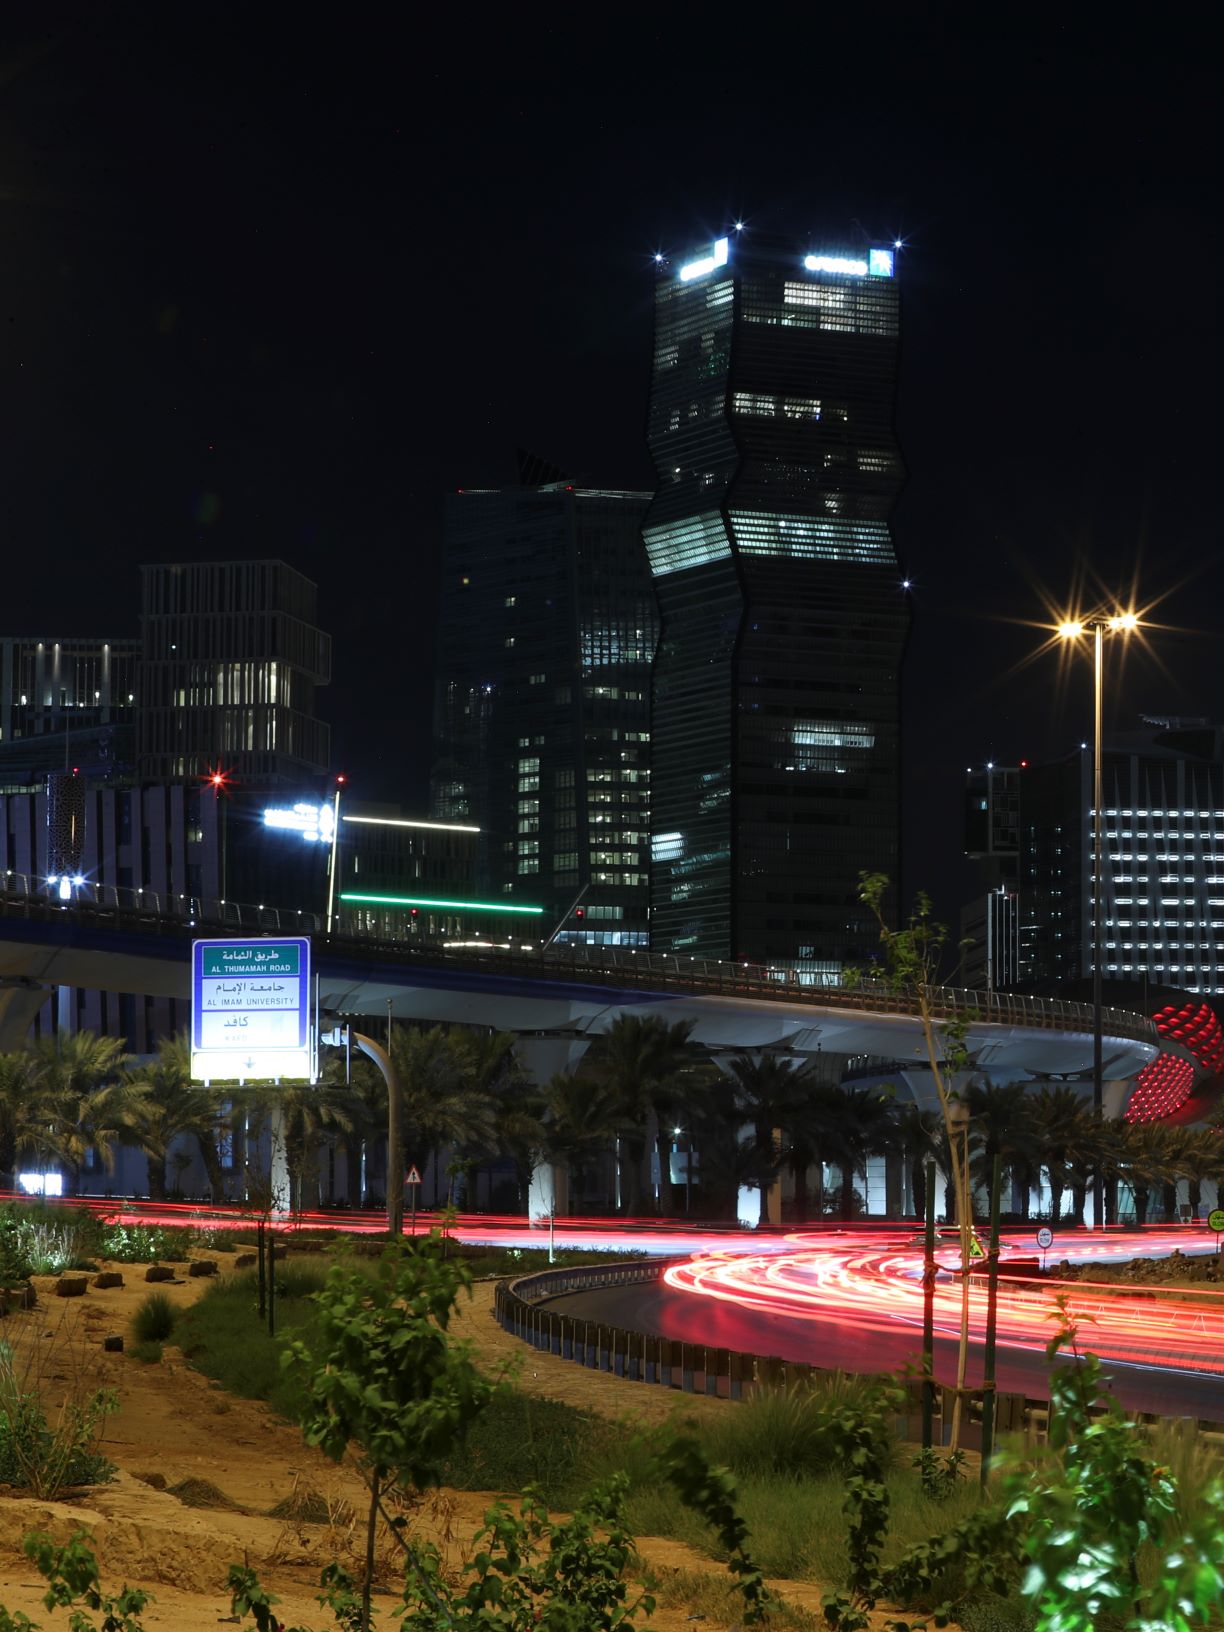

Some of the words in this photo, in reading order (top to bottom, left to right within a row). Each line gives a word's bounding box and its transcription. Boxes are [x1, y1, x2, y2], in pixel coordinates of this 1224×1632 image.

[255, 950, 279, 961] طريق
[250, 982, 285, 993] جامعة
[222, 998, 242, 1006] IMAM
[247, 997, 294, 1006] UNIVERSITY
